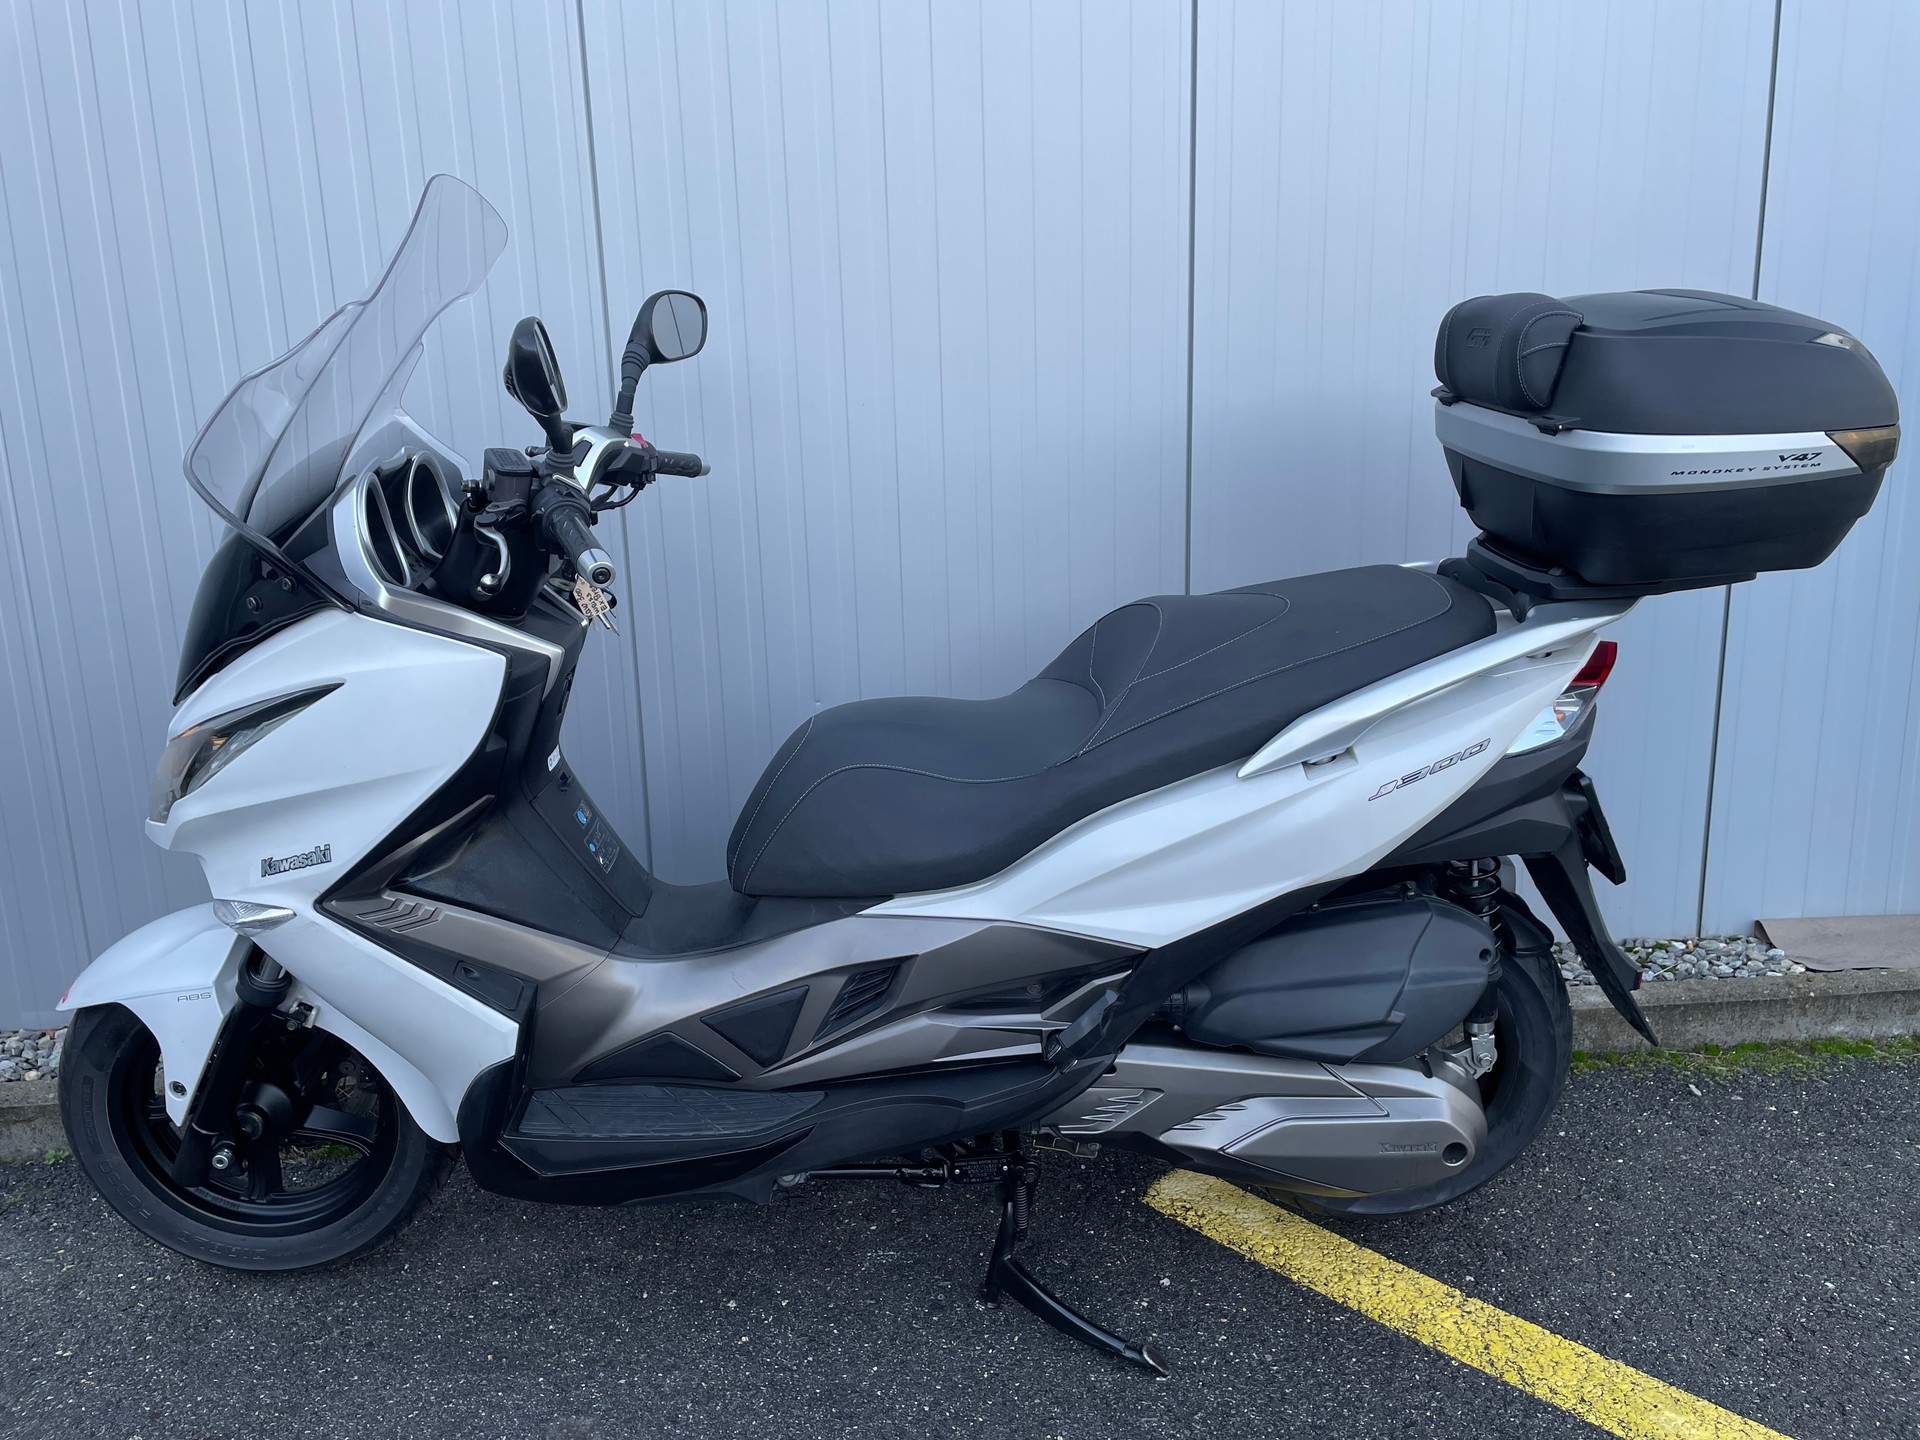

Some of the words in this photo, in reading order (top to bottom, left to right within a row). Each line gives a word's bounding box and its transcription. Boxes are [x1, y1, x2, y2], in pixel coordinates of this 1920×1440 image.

[1778, 452, 1823, 463] V47
[1670, 467, 1757, 476] MONOKEY
[1762, 462, 1822, 471] SYSTEM
[1368, 738, 1491, 801] J300
[261, 844, 332, 877] Kawasaki
[177, 992, 211, 1002] ABS
[1378, 1142, 1438, 1152] Kawasaki
